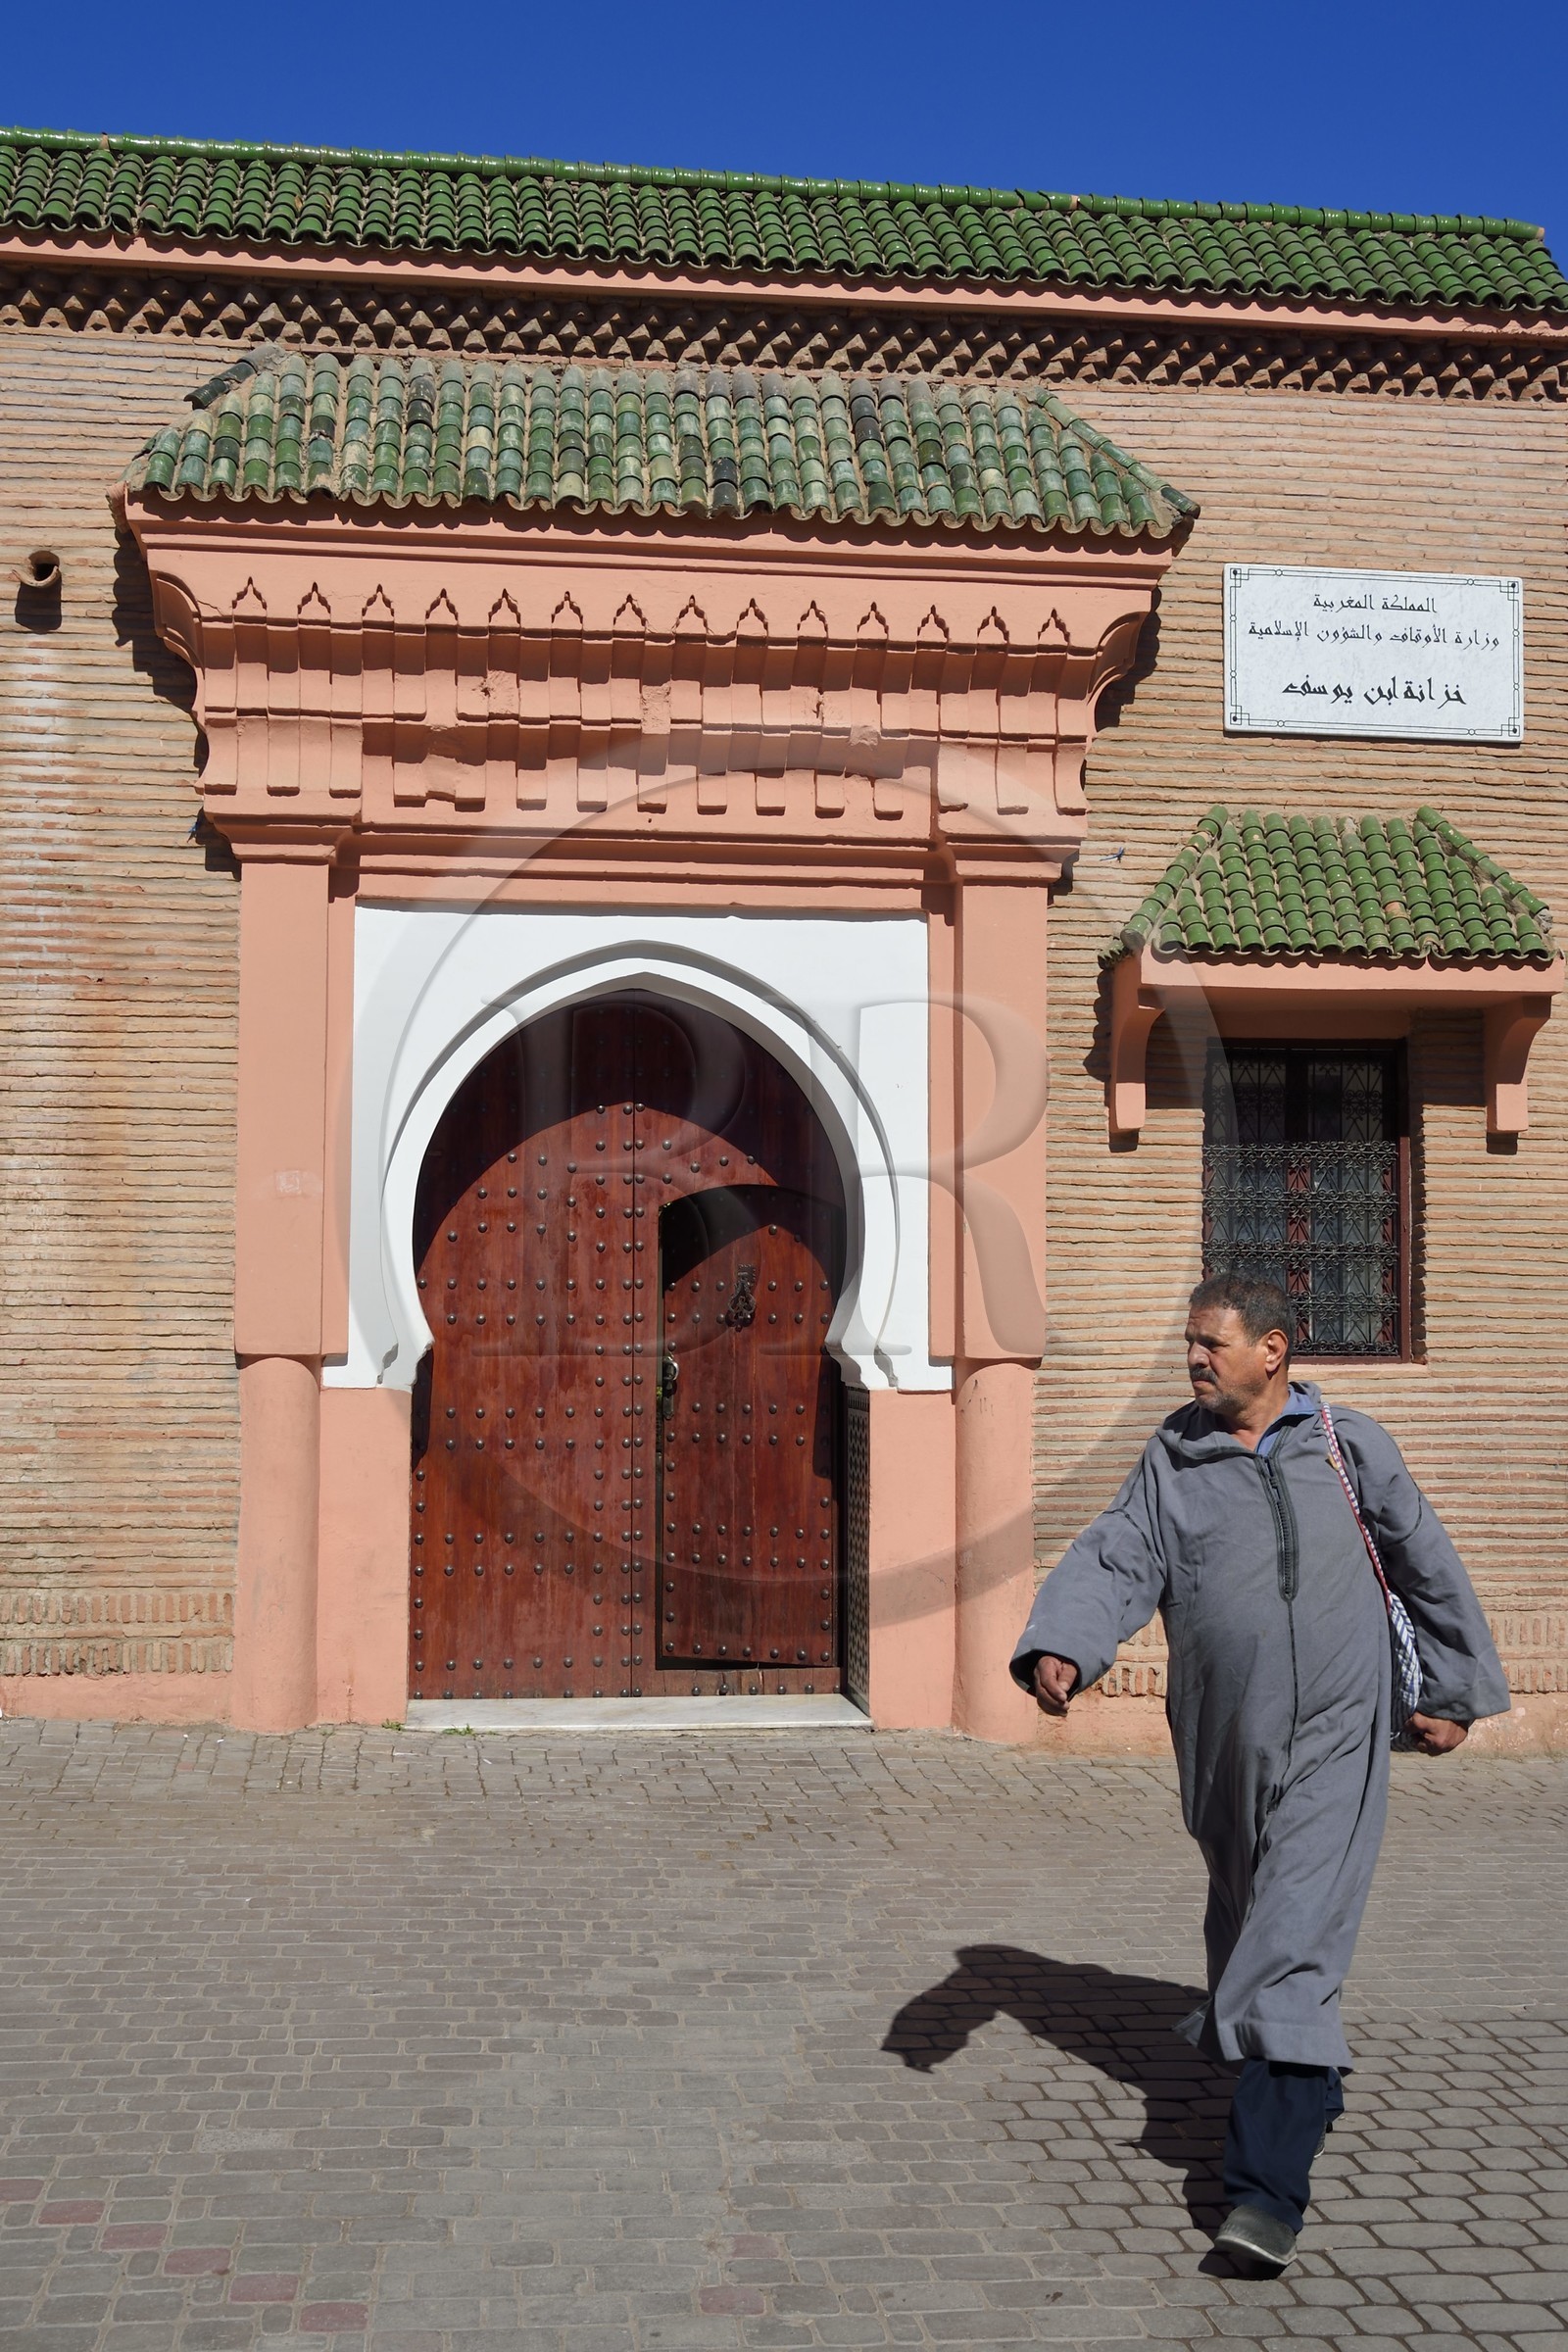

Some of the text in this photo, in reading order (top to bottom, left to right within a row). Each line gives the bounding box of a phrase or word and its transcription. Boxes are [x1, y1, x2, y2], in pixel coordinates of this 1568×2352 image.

[1313, 593, 1438, 613] المملكة المغربية
[1248, 619, 1309, 642] الإسلامية
[1389, 623, 1448, 648] الأوقاف
[1454, 629, 1500, 652] وزارة
[1281, 673, 1354, 705] يوسف
[1363, 675, 1399, 707] ابن
